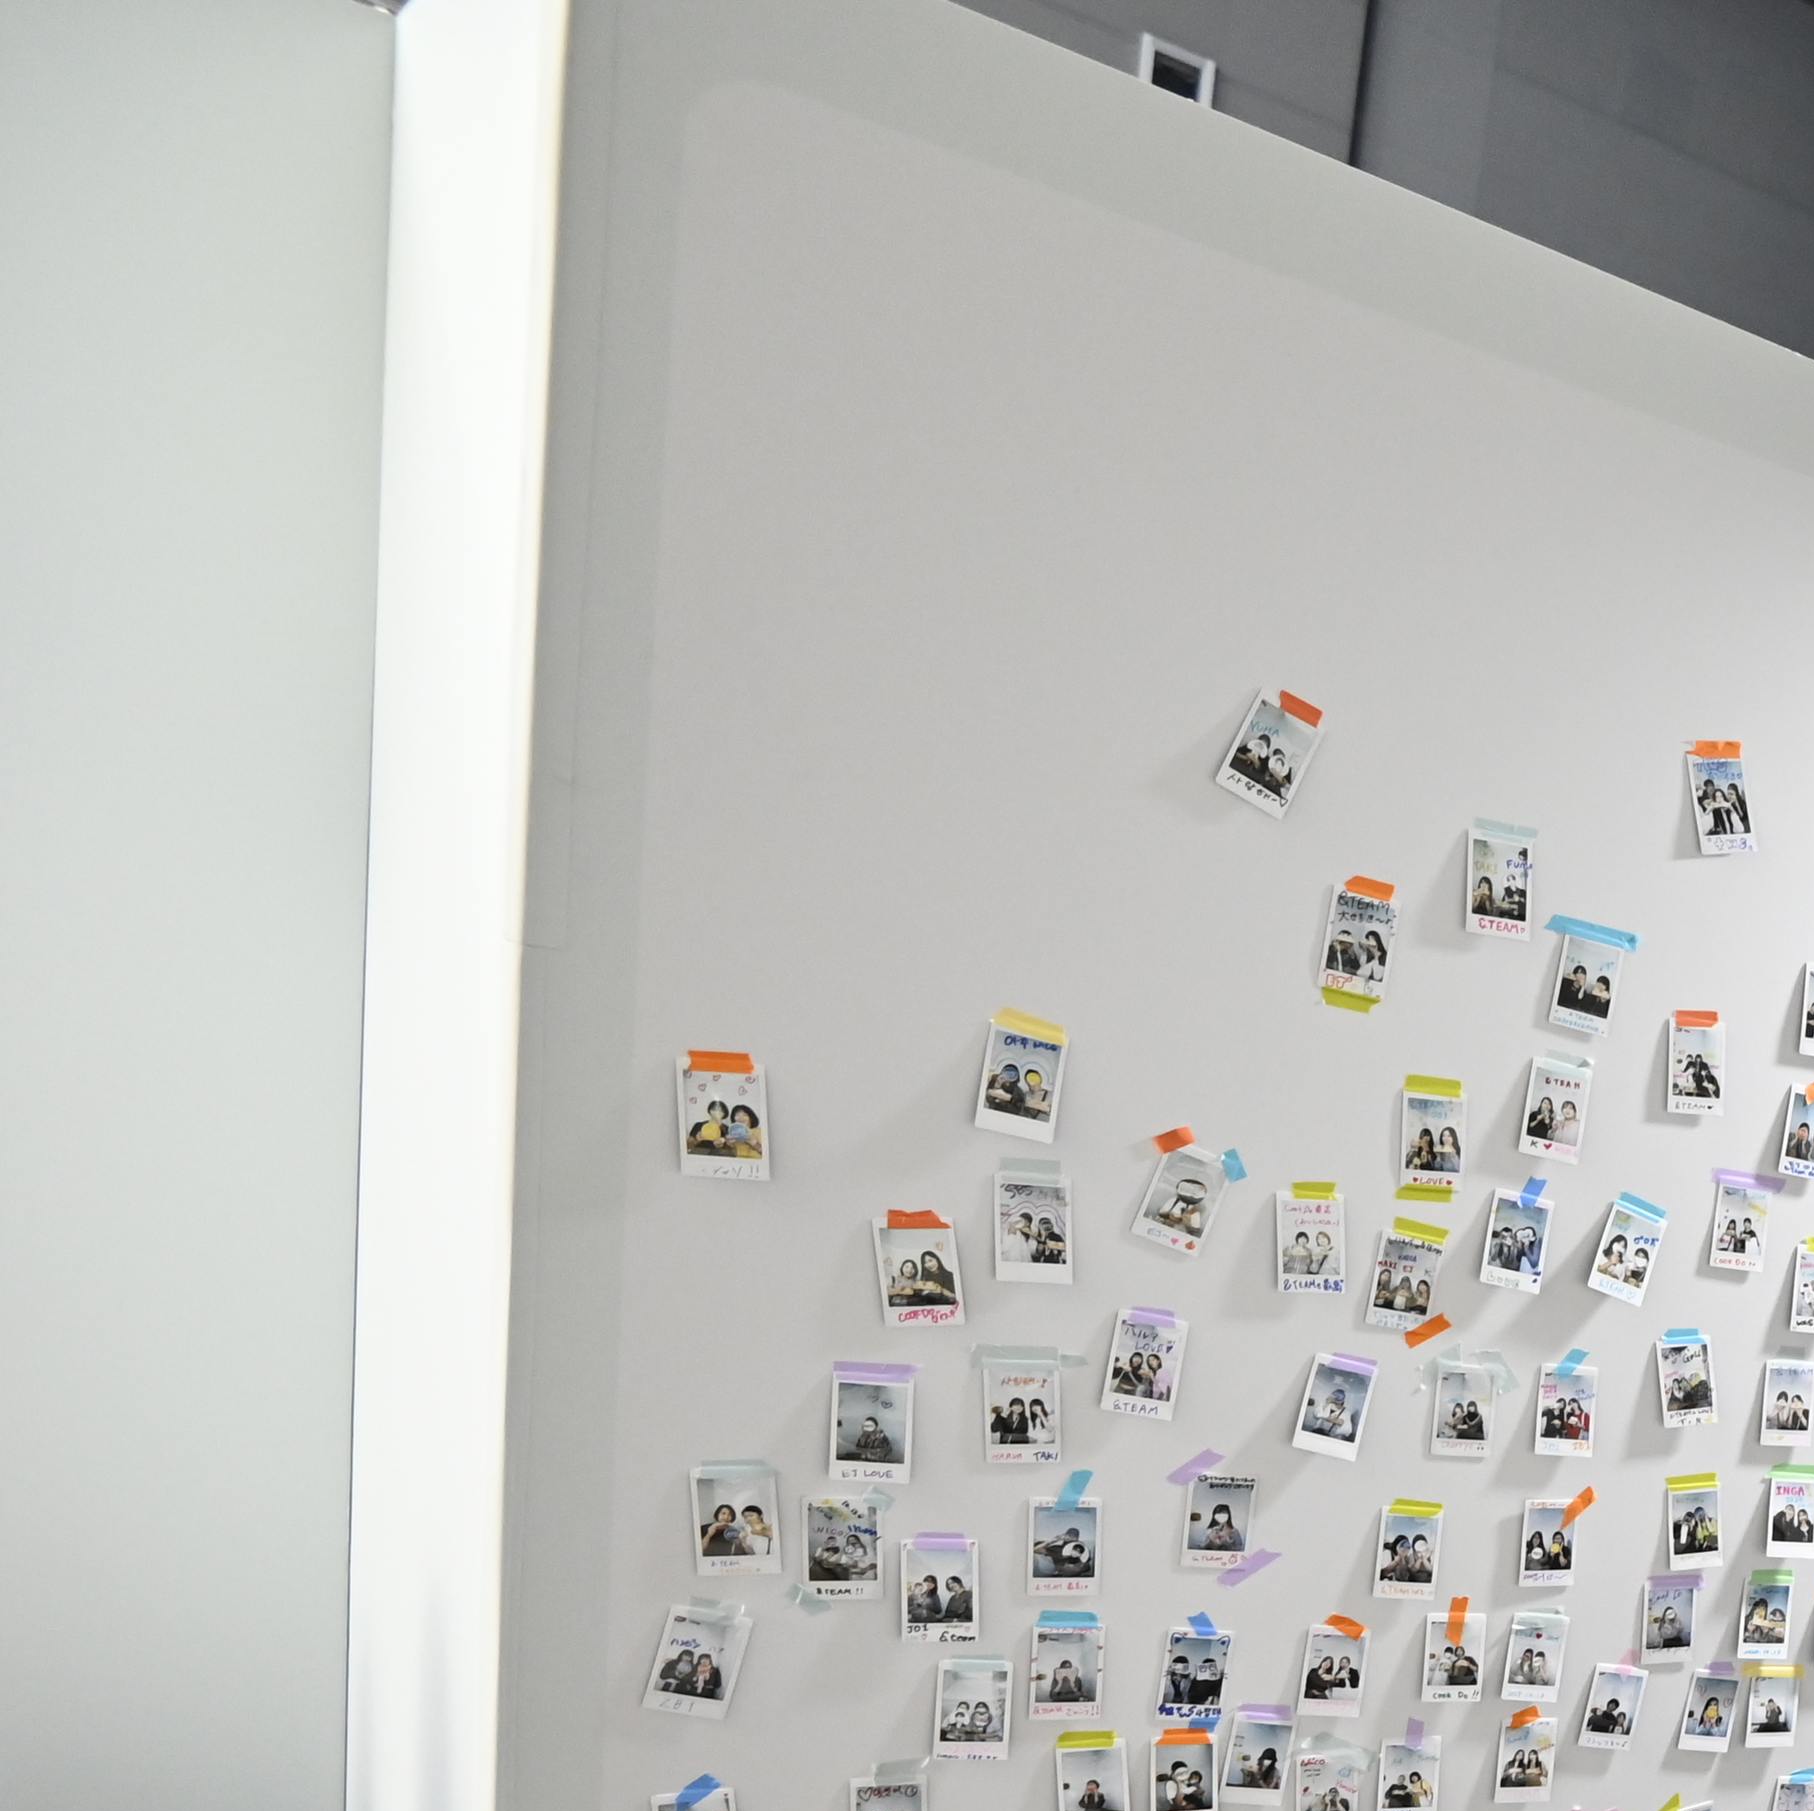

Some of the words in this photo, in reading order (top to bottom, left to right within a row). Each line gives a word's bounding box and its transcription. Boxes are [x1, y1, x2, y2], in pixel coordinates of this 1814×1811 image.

[1112, 1399, 1159, 1415] &TEAM
[1033, 1451, 1059, 1461] TAKI
[863, 1469, 895, 1480] LOVE
